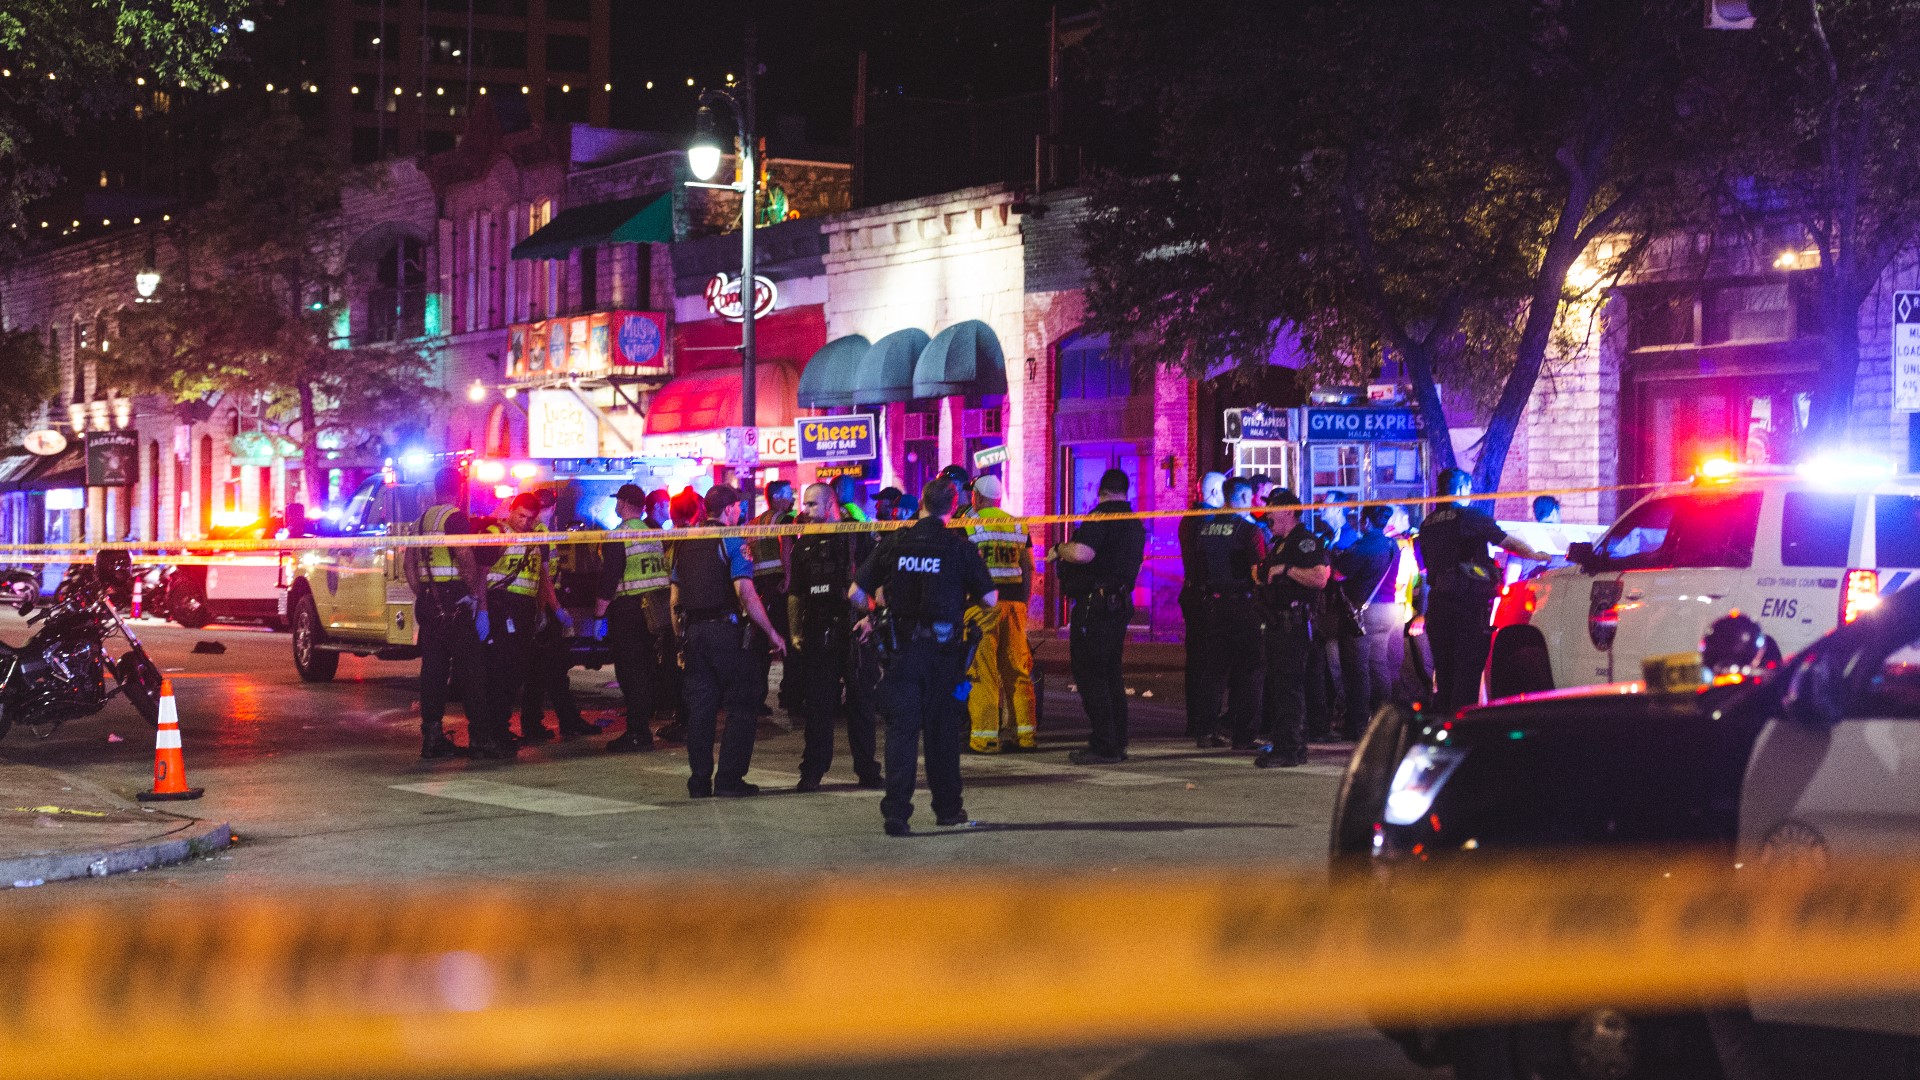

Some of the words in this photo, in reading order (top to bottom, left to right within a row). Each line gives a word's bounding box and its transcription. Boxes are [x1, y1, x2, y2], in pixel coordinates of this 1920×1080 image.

[1311, 414, 1360, 430] GYRO
[1364, 414, 1426, 430] EXPRES
[804, 423, 868, 442] Cheers
[1348, 430, 1371, 438] HALAL
[816, 440, 838, 450] SHOT
[838, 439, 857, 449] BAR
[817, 468, 842, 478] PATIO
[843, 466, 861, 475] BAR
[898, 557, 941, 573] POLICE
[810, 583, 830, 594] POLICE
[1761, 598, 1798, 619] EMS
